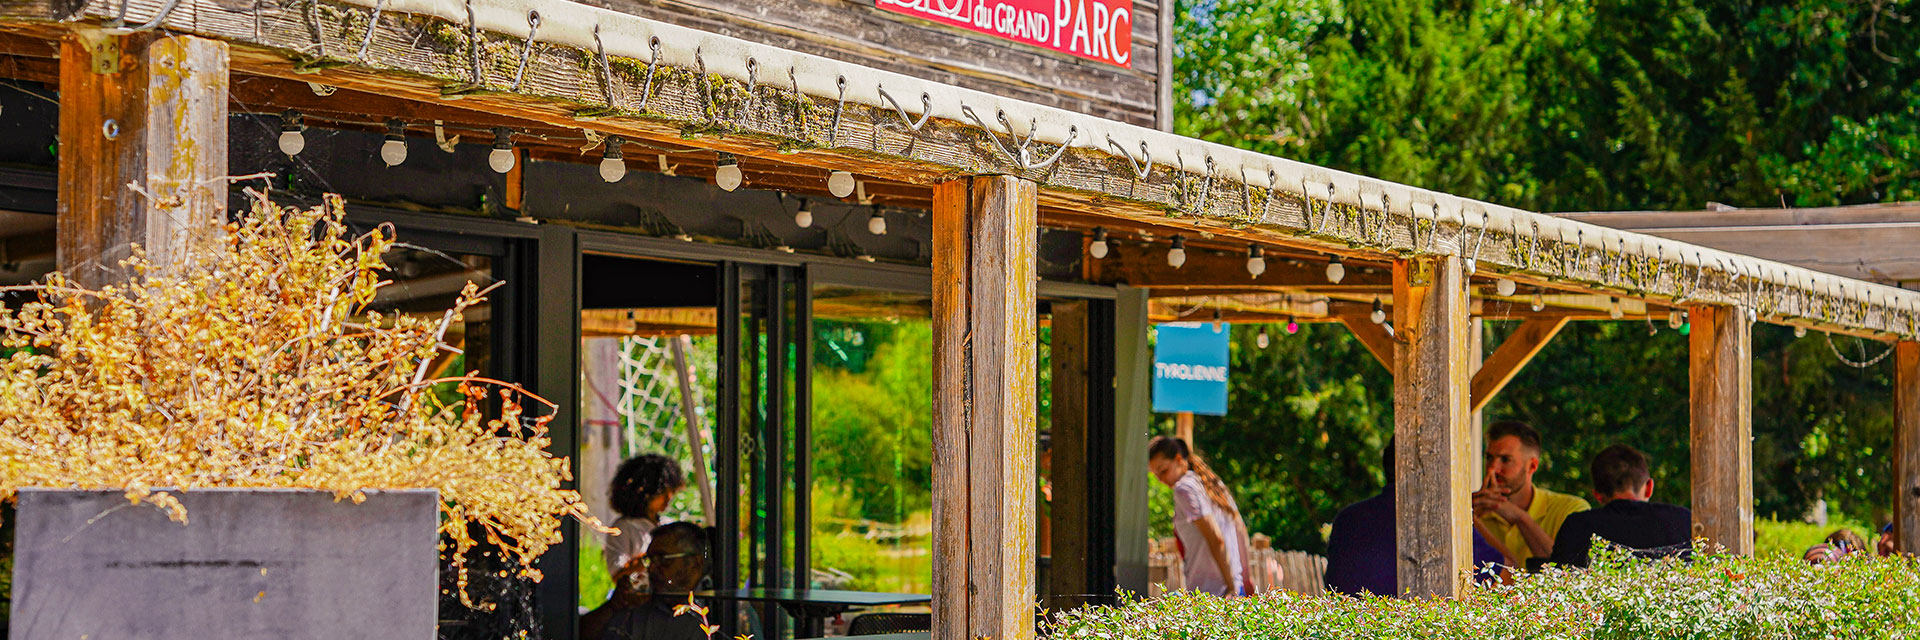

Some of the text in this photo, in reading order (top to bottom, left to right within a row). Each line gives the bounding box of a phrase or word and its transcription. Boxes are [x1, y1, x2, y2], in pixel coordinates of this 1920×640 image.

[973, 0, 993, 29] du
[994, 2, 1050, 43] GRAND
[1052, 0, 1129, 64] PARC
[1155, 362, 1227, 382] TYROLIENNE
